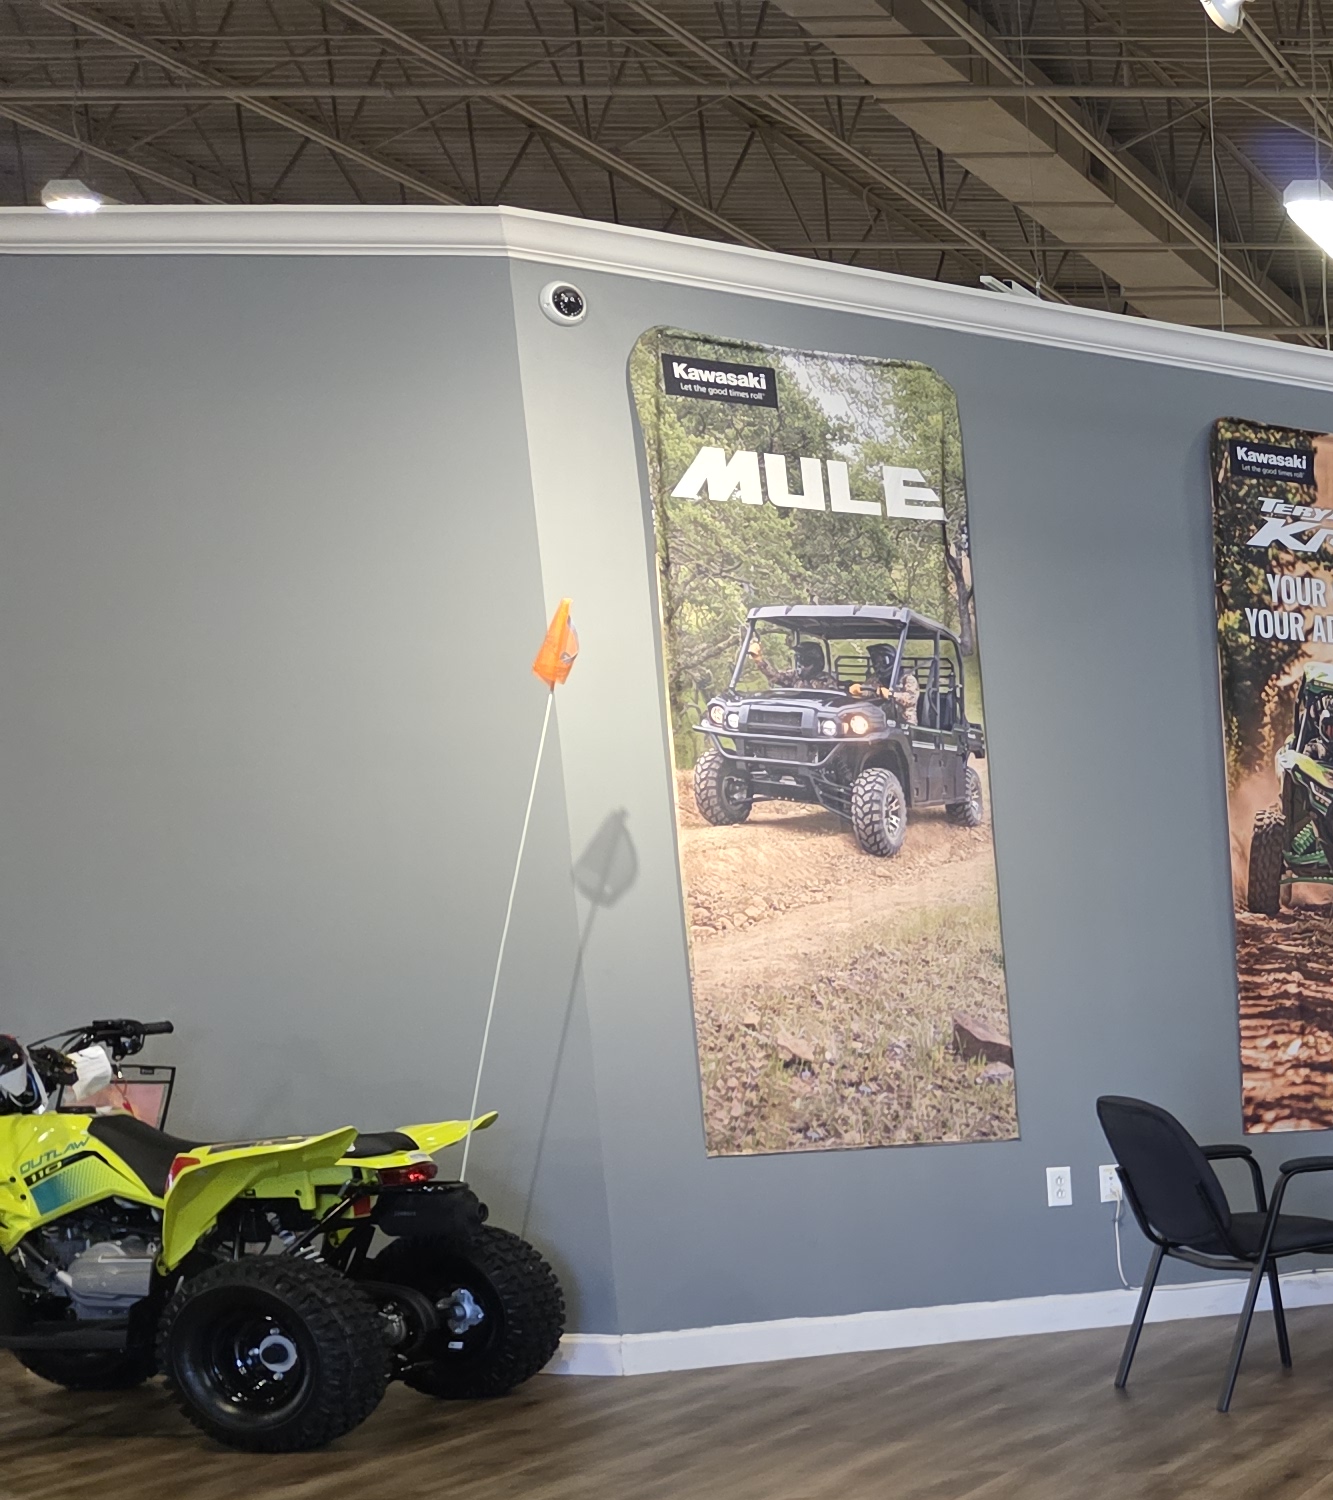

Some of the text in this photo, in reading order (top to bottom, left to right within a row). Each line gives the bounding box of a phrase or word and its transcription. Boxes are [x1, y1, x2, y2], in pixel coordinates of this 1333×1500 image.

[672, 362, 767, 390] Kawasaki
[680, 382, 692, 392] Let
[694, 384, 706, 393] the
[708, 387, 728, 396] good
[729, 389, 749, 399] times
[1236, 446, 1307, 470] Kawasaki
[1241, 464, 1251, 472] Let
[1251, 465, 1261, 473] the
[1262, 467, 1277, 475] good
[670, 446, 947, 522] MULE
[1266, 573, 1326, 607] YOUR
[1244, 607, 1305, 642] YOUR
[20, 1137, 91, 1174] OUTLAW
[30, 1161, 62, 1183] 110
